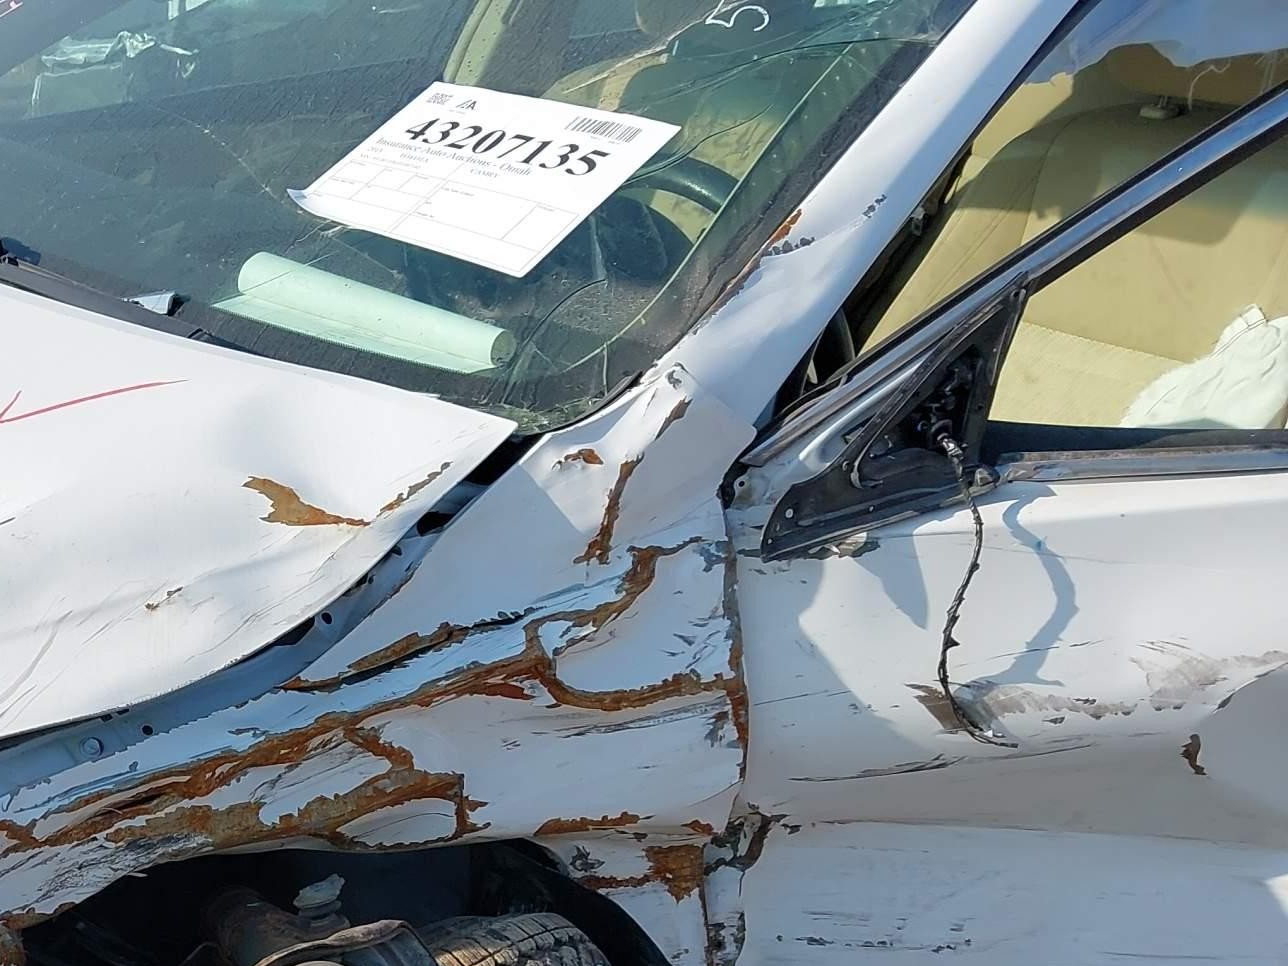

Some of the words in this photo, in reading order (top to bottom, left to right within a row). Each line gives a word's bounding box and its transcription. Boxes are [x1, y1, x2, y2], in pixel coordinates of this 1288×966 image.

[376, 137, 422, 153] Insurance
[422, 146, 448, 159] Auto
[448, 151, 492, 168] Auctions
[404, 117, 612, 176] 43207135
